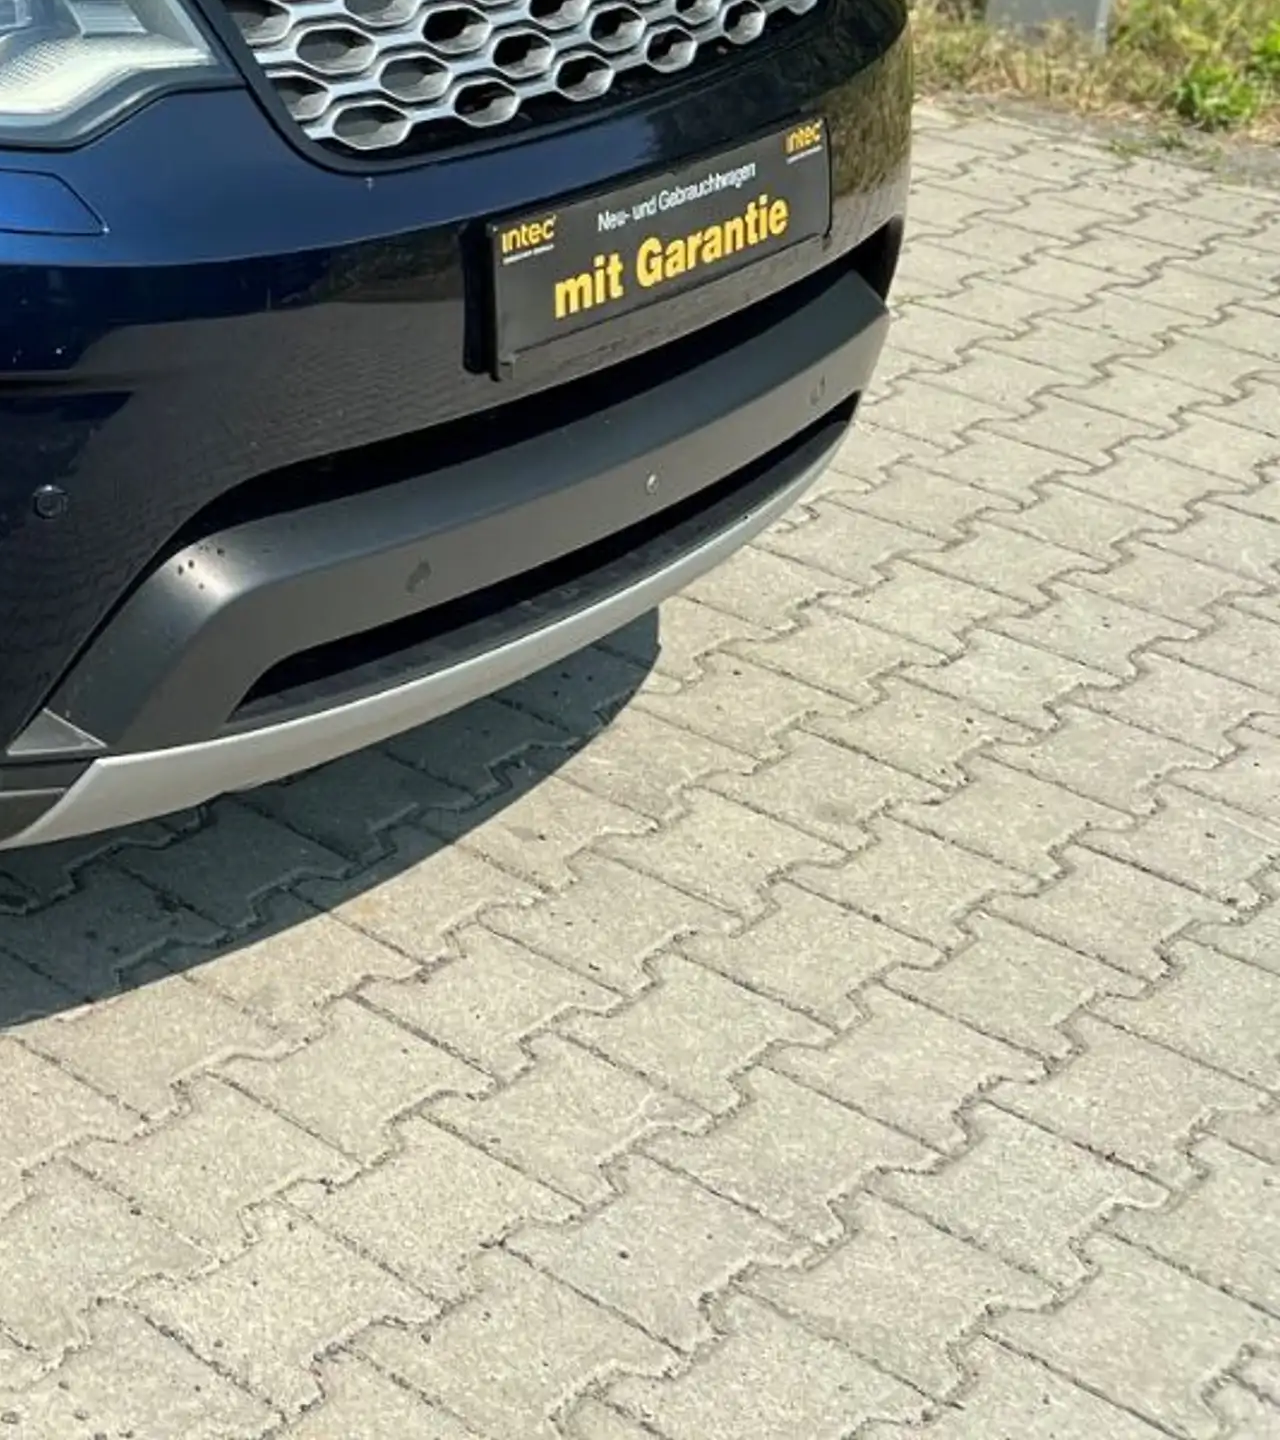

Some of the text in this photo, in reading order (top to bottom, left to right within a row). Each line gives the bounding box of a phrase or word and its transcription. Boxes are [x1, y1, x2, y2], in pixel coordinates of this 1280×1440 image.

[786, 120, 822, 155] intec
[632, 195, 657, 222] und
[502, 215, 557, 254] intec
[554, 194, 789, 320] mit Garantie
